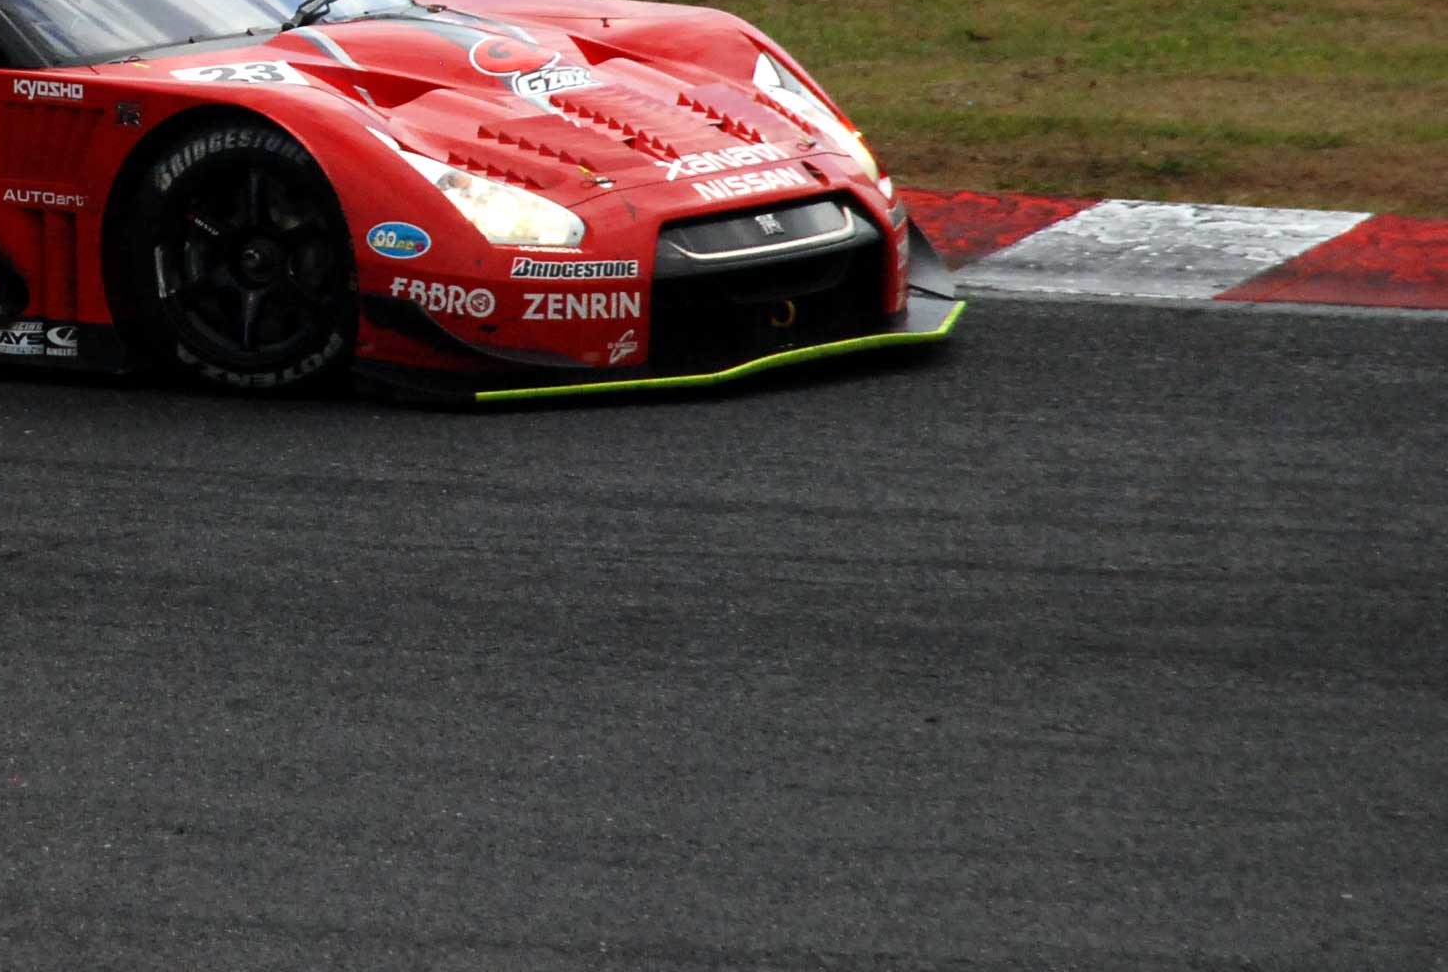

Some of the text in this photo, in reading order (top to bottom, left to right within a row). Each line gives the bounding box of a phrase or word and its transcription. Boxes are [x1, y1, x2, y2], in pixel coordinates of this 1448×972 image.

[691, 165, 809, 202] NISSAN
[512, 258, 639, 280] BRIDGESTONE
[521, 291, 642, 321] ZENRIN
